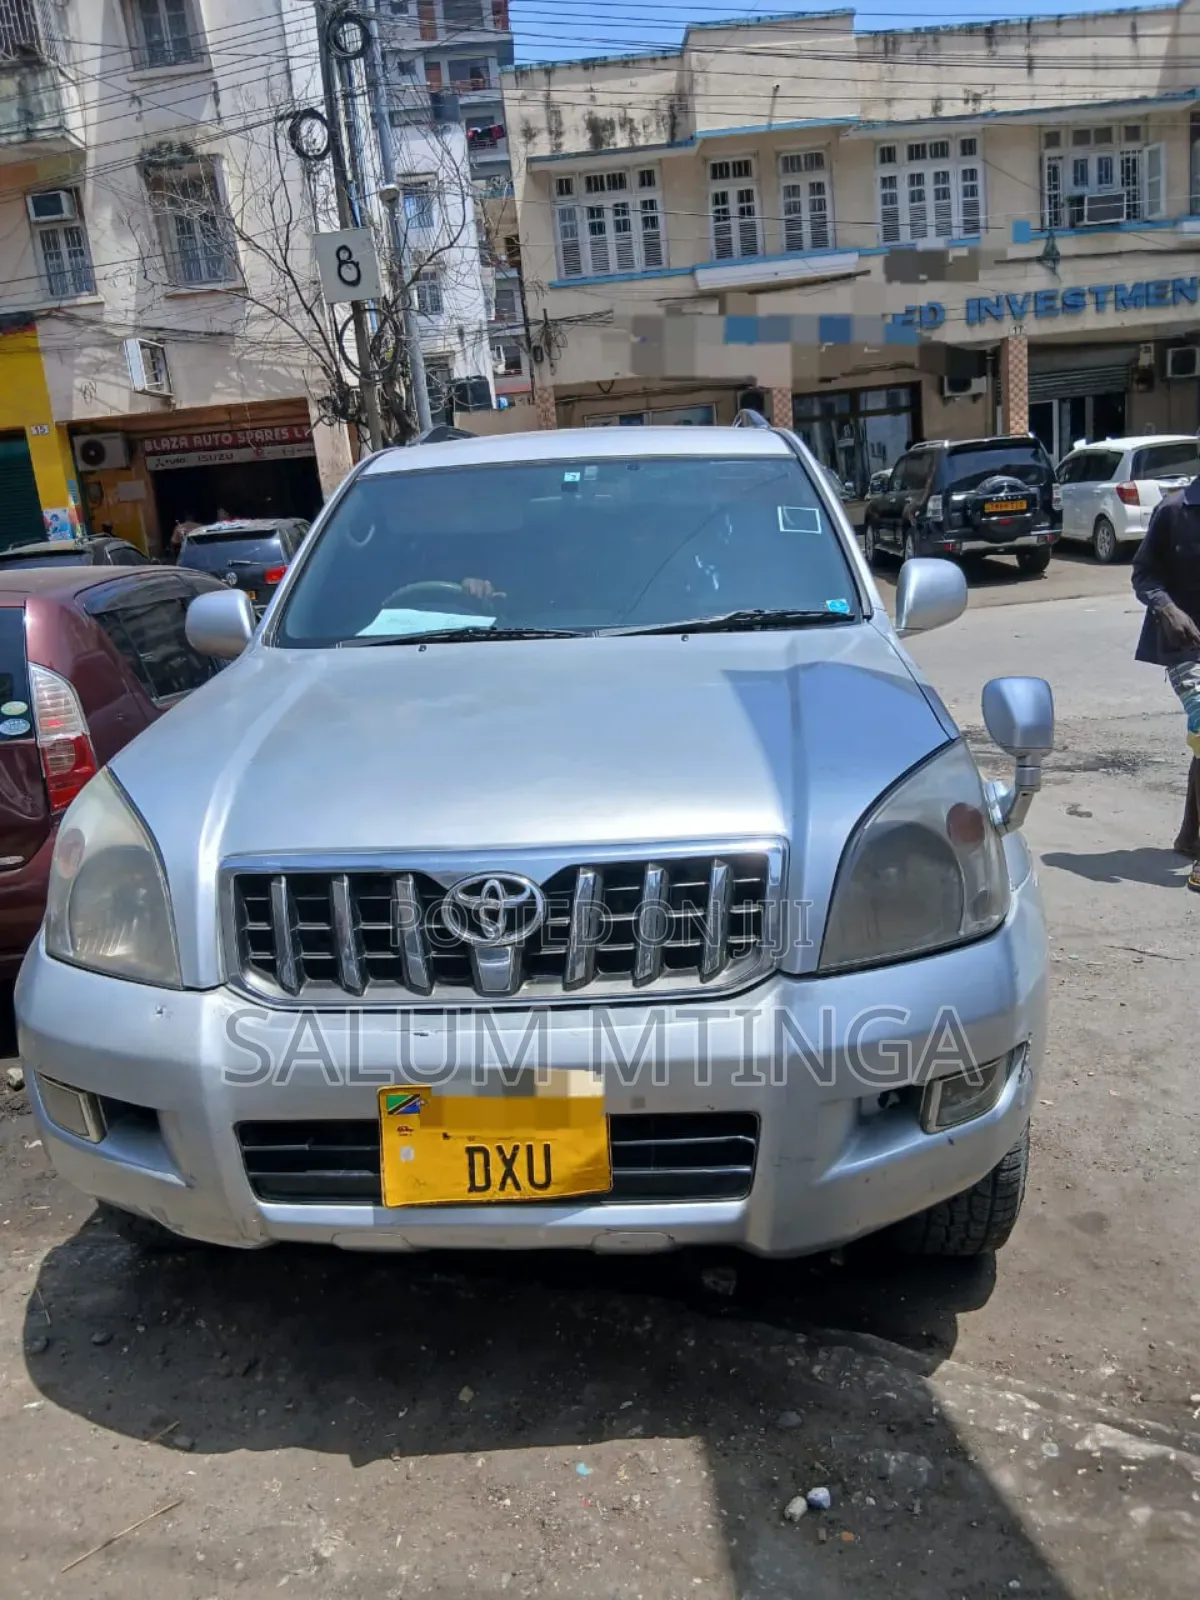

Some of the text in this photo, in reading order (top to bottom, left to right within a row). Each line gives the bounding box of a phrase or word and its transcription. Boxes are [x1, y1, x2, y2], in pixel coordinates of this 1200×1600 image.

[336, 245, 361, 287] 8
[966, 276, 1199, 326] INVESTMEN
[193, 432, 233, 447] AUTO
[238, 428, 290, 443] SPARES
[465, 1142, 552, 1193] DXU
